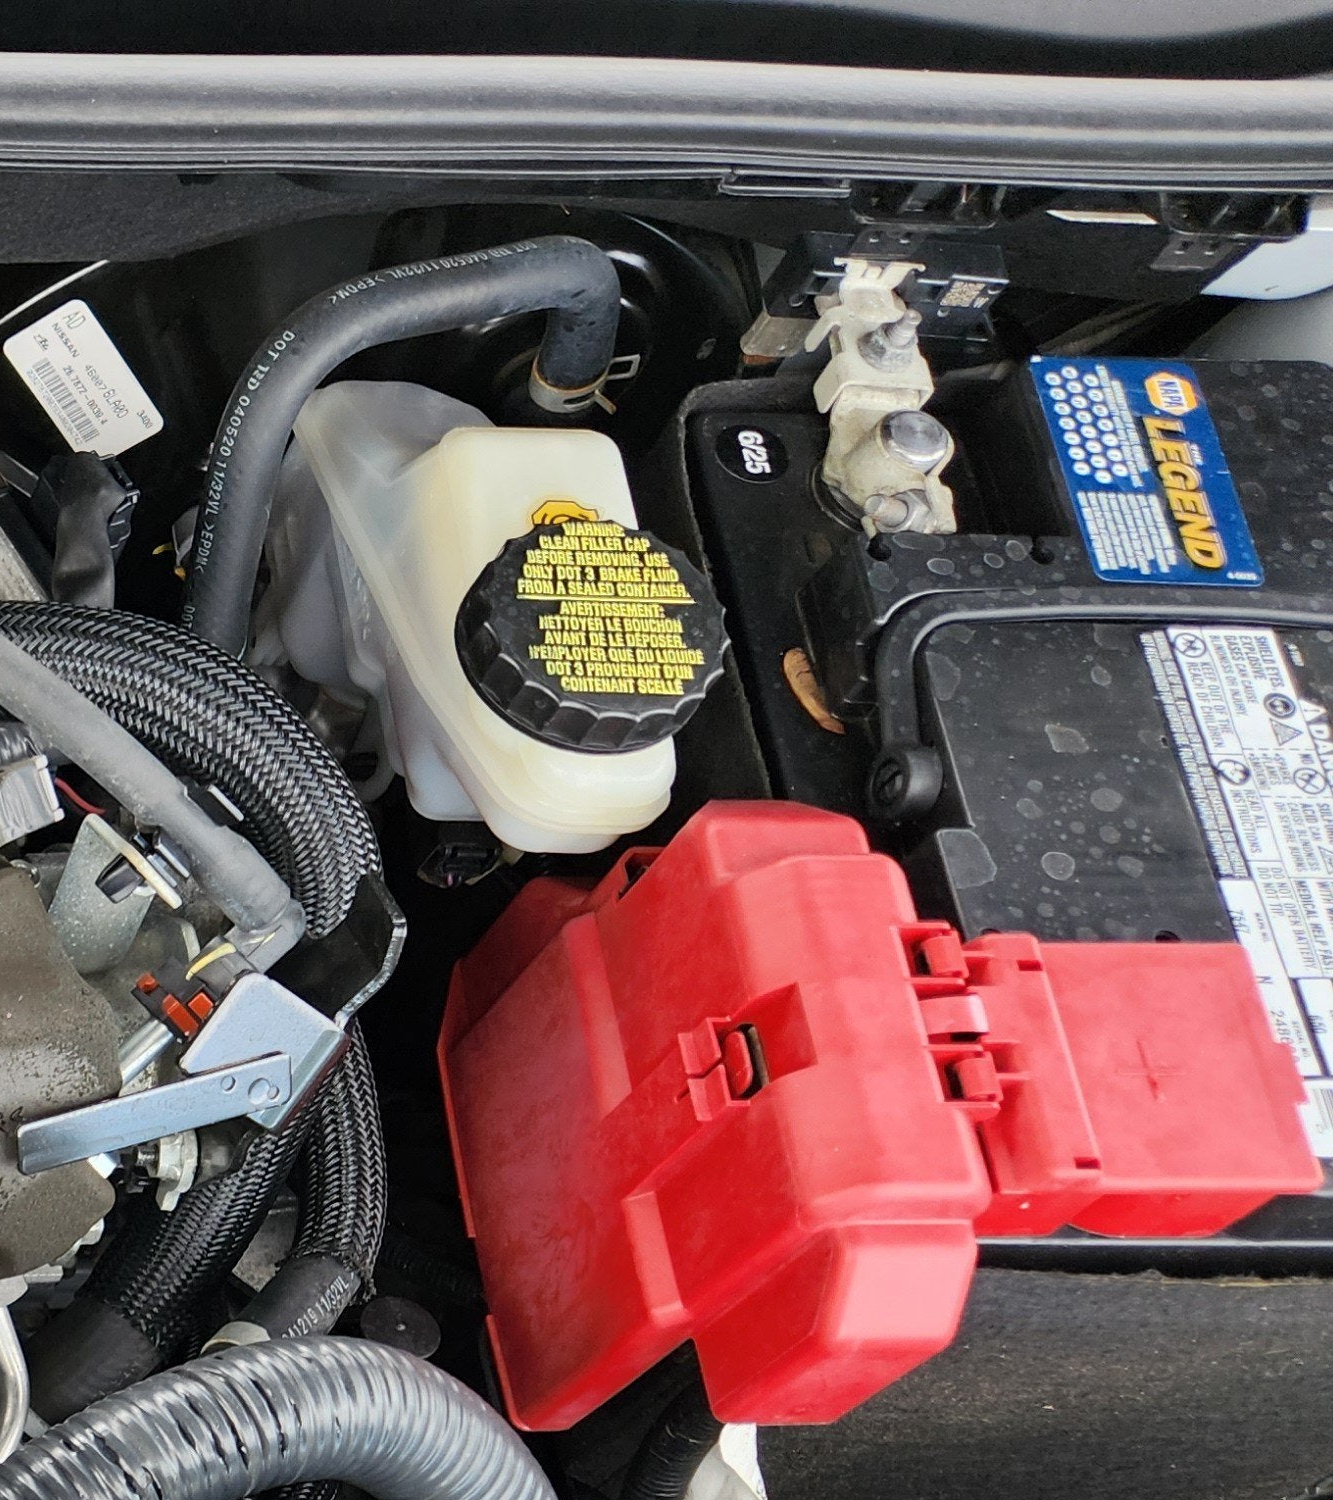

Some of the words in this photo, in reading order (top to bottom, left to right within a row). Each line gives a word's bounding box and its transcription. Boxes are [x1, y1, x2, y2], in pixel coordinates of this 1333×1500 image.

[51, 322, 80, 358] NISSAN
[268, 330, 296, 362] DOT
[1157, 380, 1185, 408] NAPA
[219, 395, 251, 457] 040520
[205, 461, 227, 515] 11/32VL
[1142, 416, 1227, 569] LEGEND
[539, 536, 580, 550] CLEAN
[582, 537, 623, 551] FILLER
[624, 538, 651, 552] CAP
[526, 550, 575, 565] BEFORE
[644, 553, 669, 567] USE
[523, 564, 553, 579] ONLY
[556, 566, 582, 580] DOT
[584, 567, 595, 581] 3
[599, 567, 643, 582] BRAKE
[643, 568, 679, 582] FLUID
[517, 579, 554, 594] FROM
[556, 581, 567, 595] A
[568, 581, 615, 596] SEALED
[616, 582, 691, 598] CONTAINER.
[560, 601, 665, 618] AVERTISSEMENT:
[538, 616, 603, 631] NETTOYER
[606, 618, 622, 632] LE
[624, 618, 683, 633] BOUCHON
[544, 631, 587, 645] AVANT
[590, 632, 607, 647] DE
[608, 632, 624, 647] LE
[1224, 635, 1244, 661] GASES
[608, 648, 635, 662] QUE
[636, 649, 654, 664] DU
[656, 649, 705, 665] LIQUIDE
[1210, 635, 1235, 676] BLINDNESS
[1239, 635, 1267, 680] EXPLOSIVE
[1255, 635, 1274, 664] SHIELD
[546, 661, 572, 676] DOT
[574, 662, 585, 676] 3
[586, 663, 662, 678] PROVENANT
[663, 664, 694, 680] D'UN
[1201, 662, 1217, 682] KEEP
[1238, 663, 1250, 677] CAN
[560, 677, 635, 693] CONTENANT
[1186, 662, 1203, 689] REACH
[1196, 692, 1209, 703] OF
[1241, 679, 1259, 704] CAUSE
[1208, 685, 1222, 700] OUT
[1214, 705, 1227, 716] OF
[1218, 718, 1233, 733] THE
[1300, 753, 1315, 764] NO
[1245, 790, 1263, 810] READ
[1254, 816, 1267, 828] ALL
[1300, 803, 1318, 823] ACID
[1279, 815, 1294, 844] SEVERE
[1288, 803, 1303, 826] CAUSE
[1297, 829, 1321, 871] BLINDNESS
[1257, 867, 1271, 880] DO
[1271, 867, 1284, 880] DO
[1263, 883, 1279, 900] NOT
[1277, 882, 1293, 900] NOT
[1283, 902, 1302, 927] OPEN
[1294, 880, 1317, 921] MEDICAL
[1309, 923, 1328, 948] HELP
